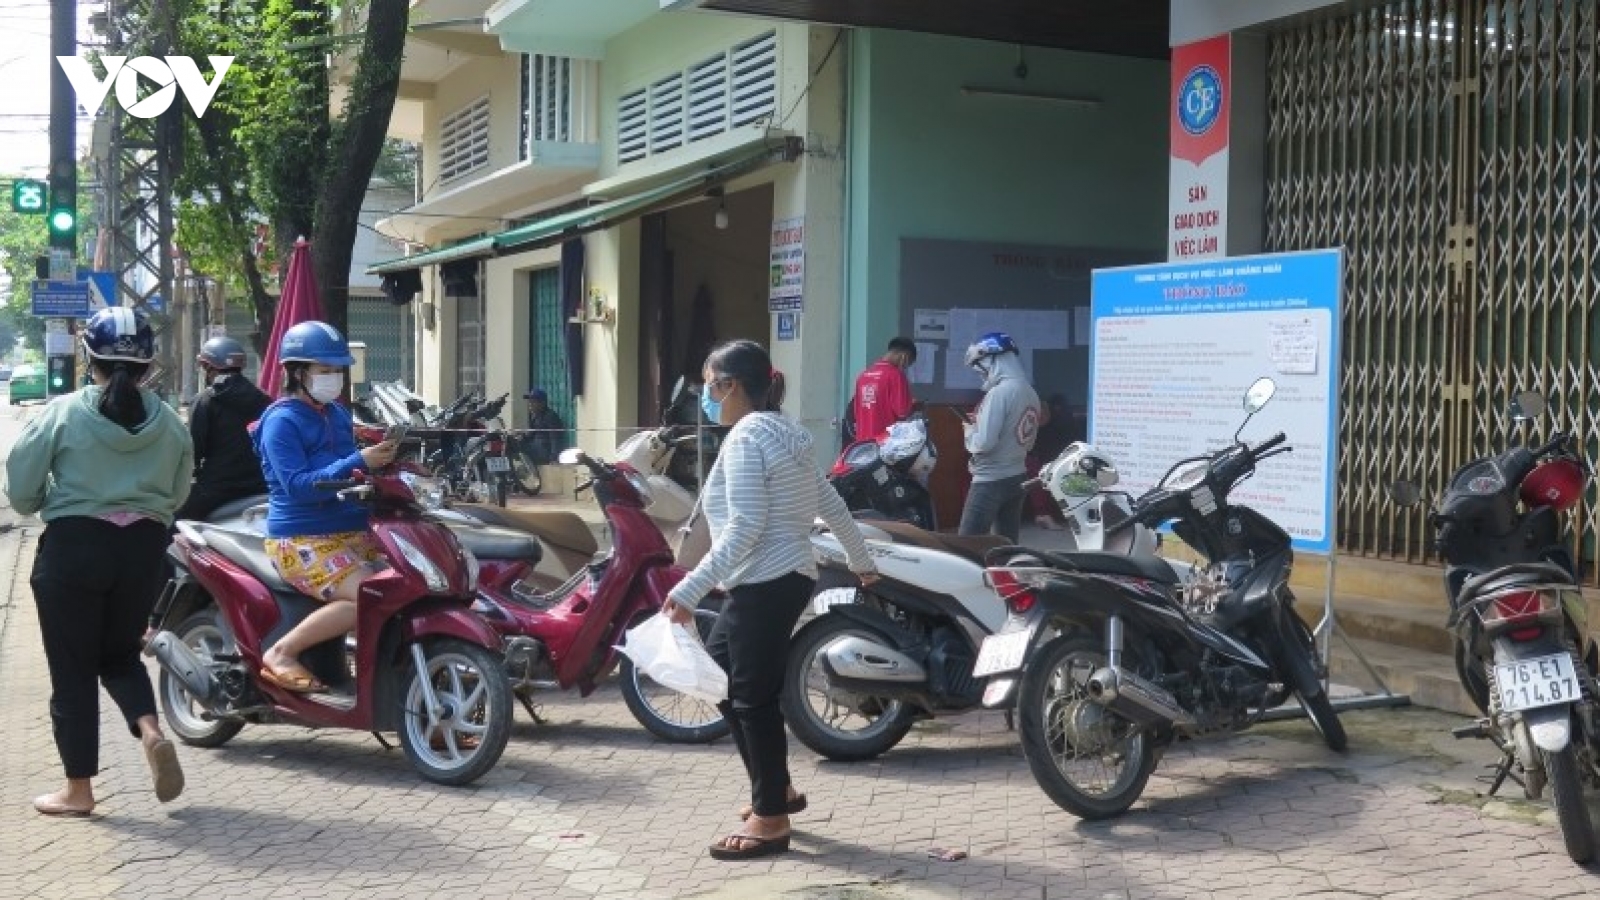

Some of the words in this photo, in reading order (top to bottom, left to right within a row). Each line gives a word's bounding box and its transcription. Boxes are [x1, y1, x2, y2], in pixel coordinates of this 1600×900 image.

[1174, 212, 1196, 230] GIAO
[1197, 210, 1220, 231] DỊCH
[1174, 236, 1196, 258] VIỆC
[1506, 679, 1573, 706] 214.87
